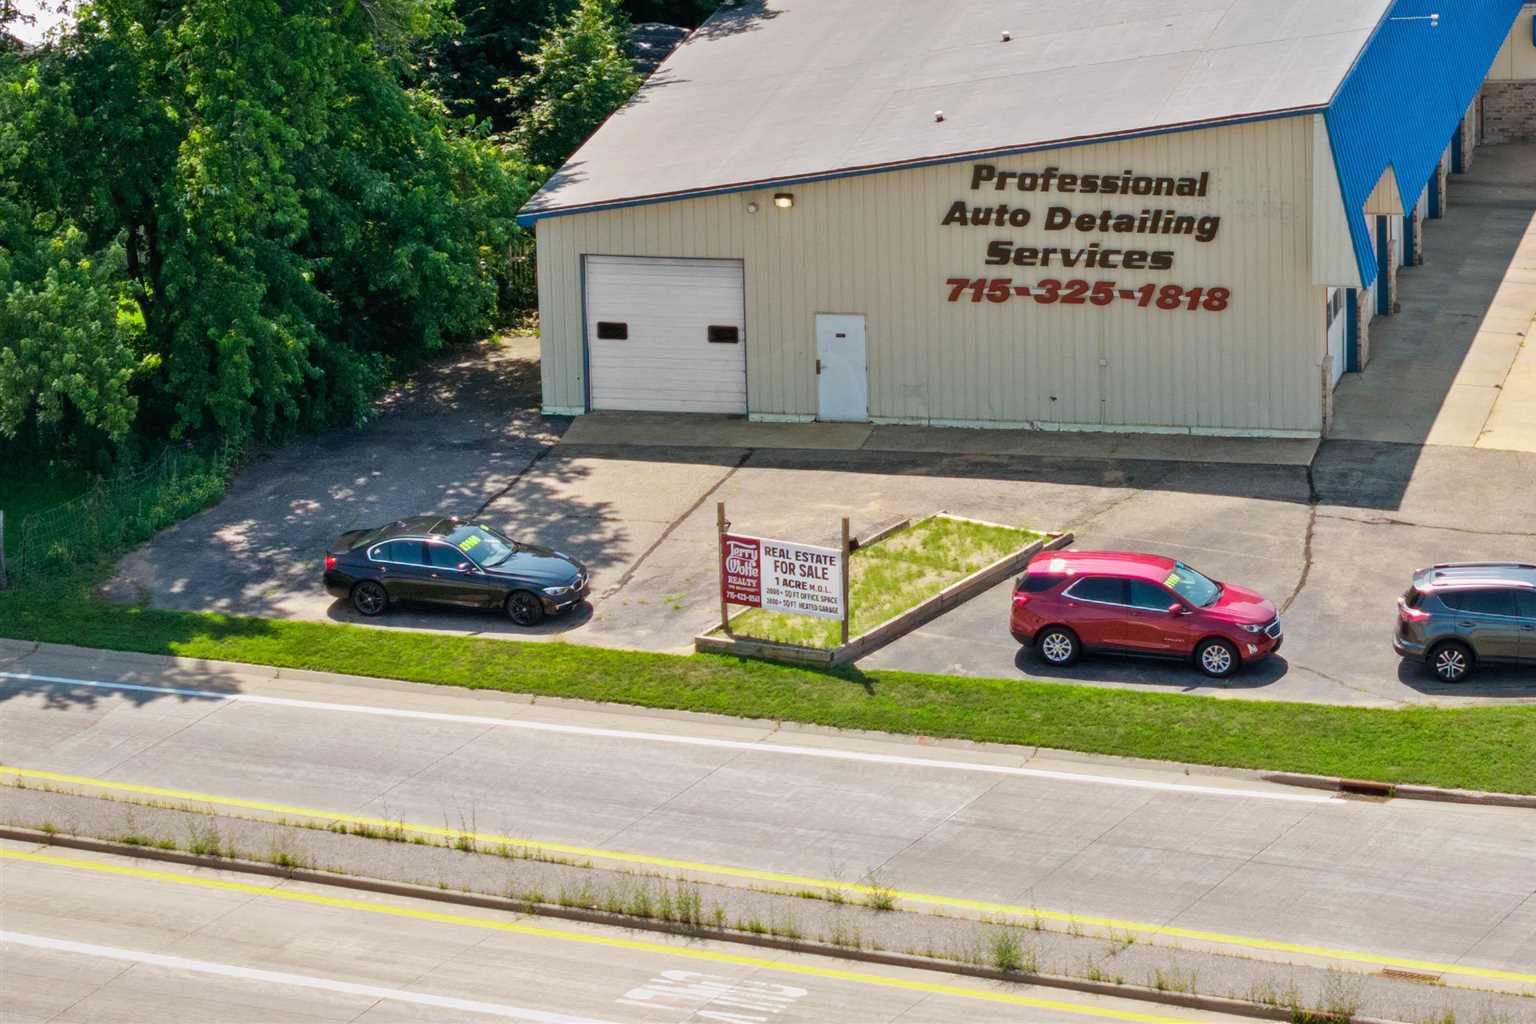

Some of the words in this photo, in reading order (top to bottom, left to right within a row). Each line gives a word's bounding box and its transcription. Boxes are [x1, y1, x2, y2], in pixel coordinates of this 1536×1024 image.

[970, 164, 1210, 197] Professional
[941, 201, 1031, 228] Auto
[1043, 205, 1221, 242] Detailing
[985, 240, 1175, 270] Services
[945, 278, 1231, 311] 715-325-1818
[726, 541, 757, 561] Terry
[764, 546, 792, 560] REAL
[795, 551, 837, 566] ESTATE
[726, 556, 759, 578] Wolfe
[774, 560, 796, 576] FOR
[799, 564, 829, 581] SALE
[728, 576, 757, 587] REALTY
[775, 577, 780, 586] 1
[782, 579, 807, 591] ACRE
[800, 592, 820, 602] OFFICE
[820, 595, 838, 605] SPACE
